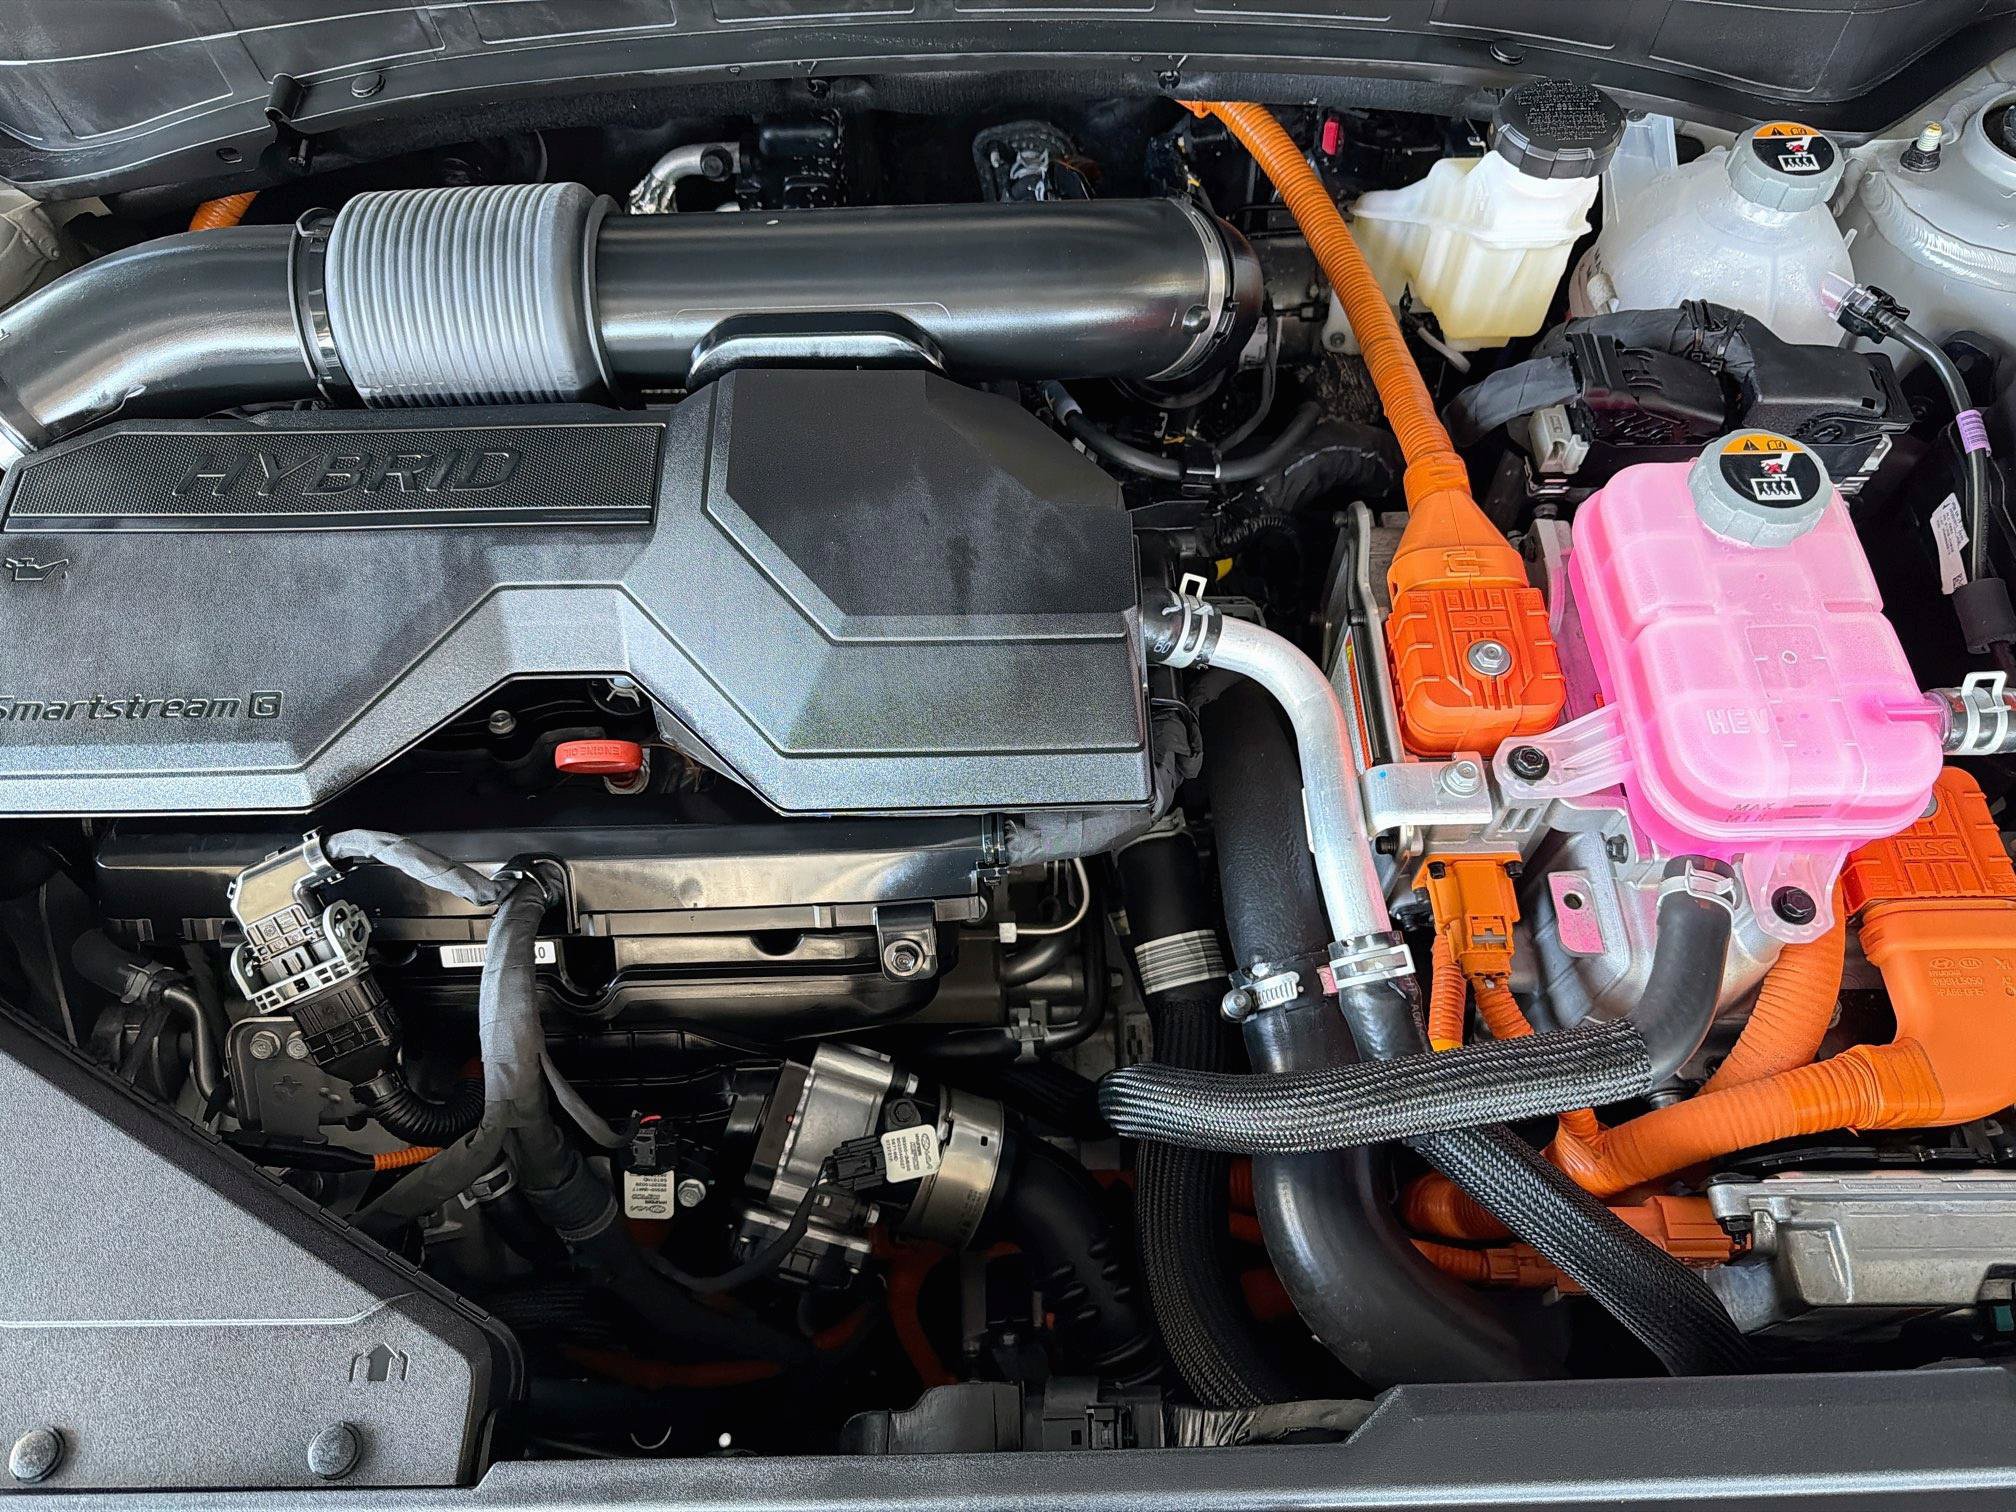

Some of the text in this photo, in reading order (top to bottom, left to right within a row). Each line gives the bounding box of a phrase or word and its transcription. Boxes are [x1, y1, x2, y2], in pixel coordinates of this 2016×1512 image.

[172, 450, 521, 496] HYBRID
[0, 693, 281, 721] Smartstream G
[1706, 708, 1771, 735] HEV
[580, 746, 620, 756] ENGINE
[1734, 803, 1776, 811] MAX
[1906, 840, 1960, 857] HSG
